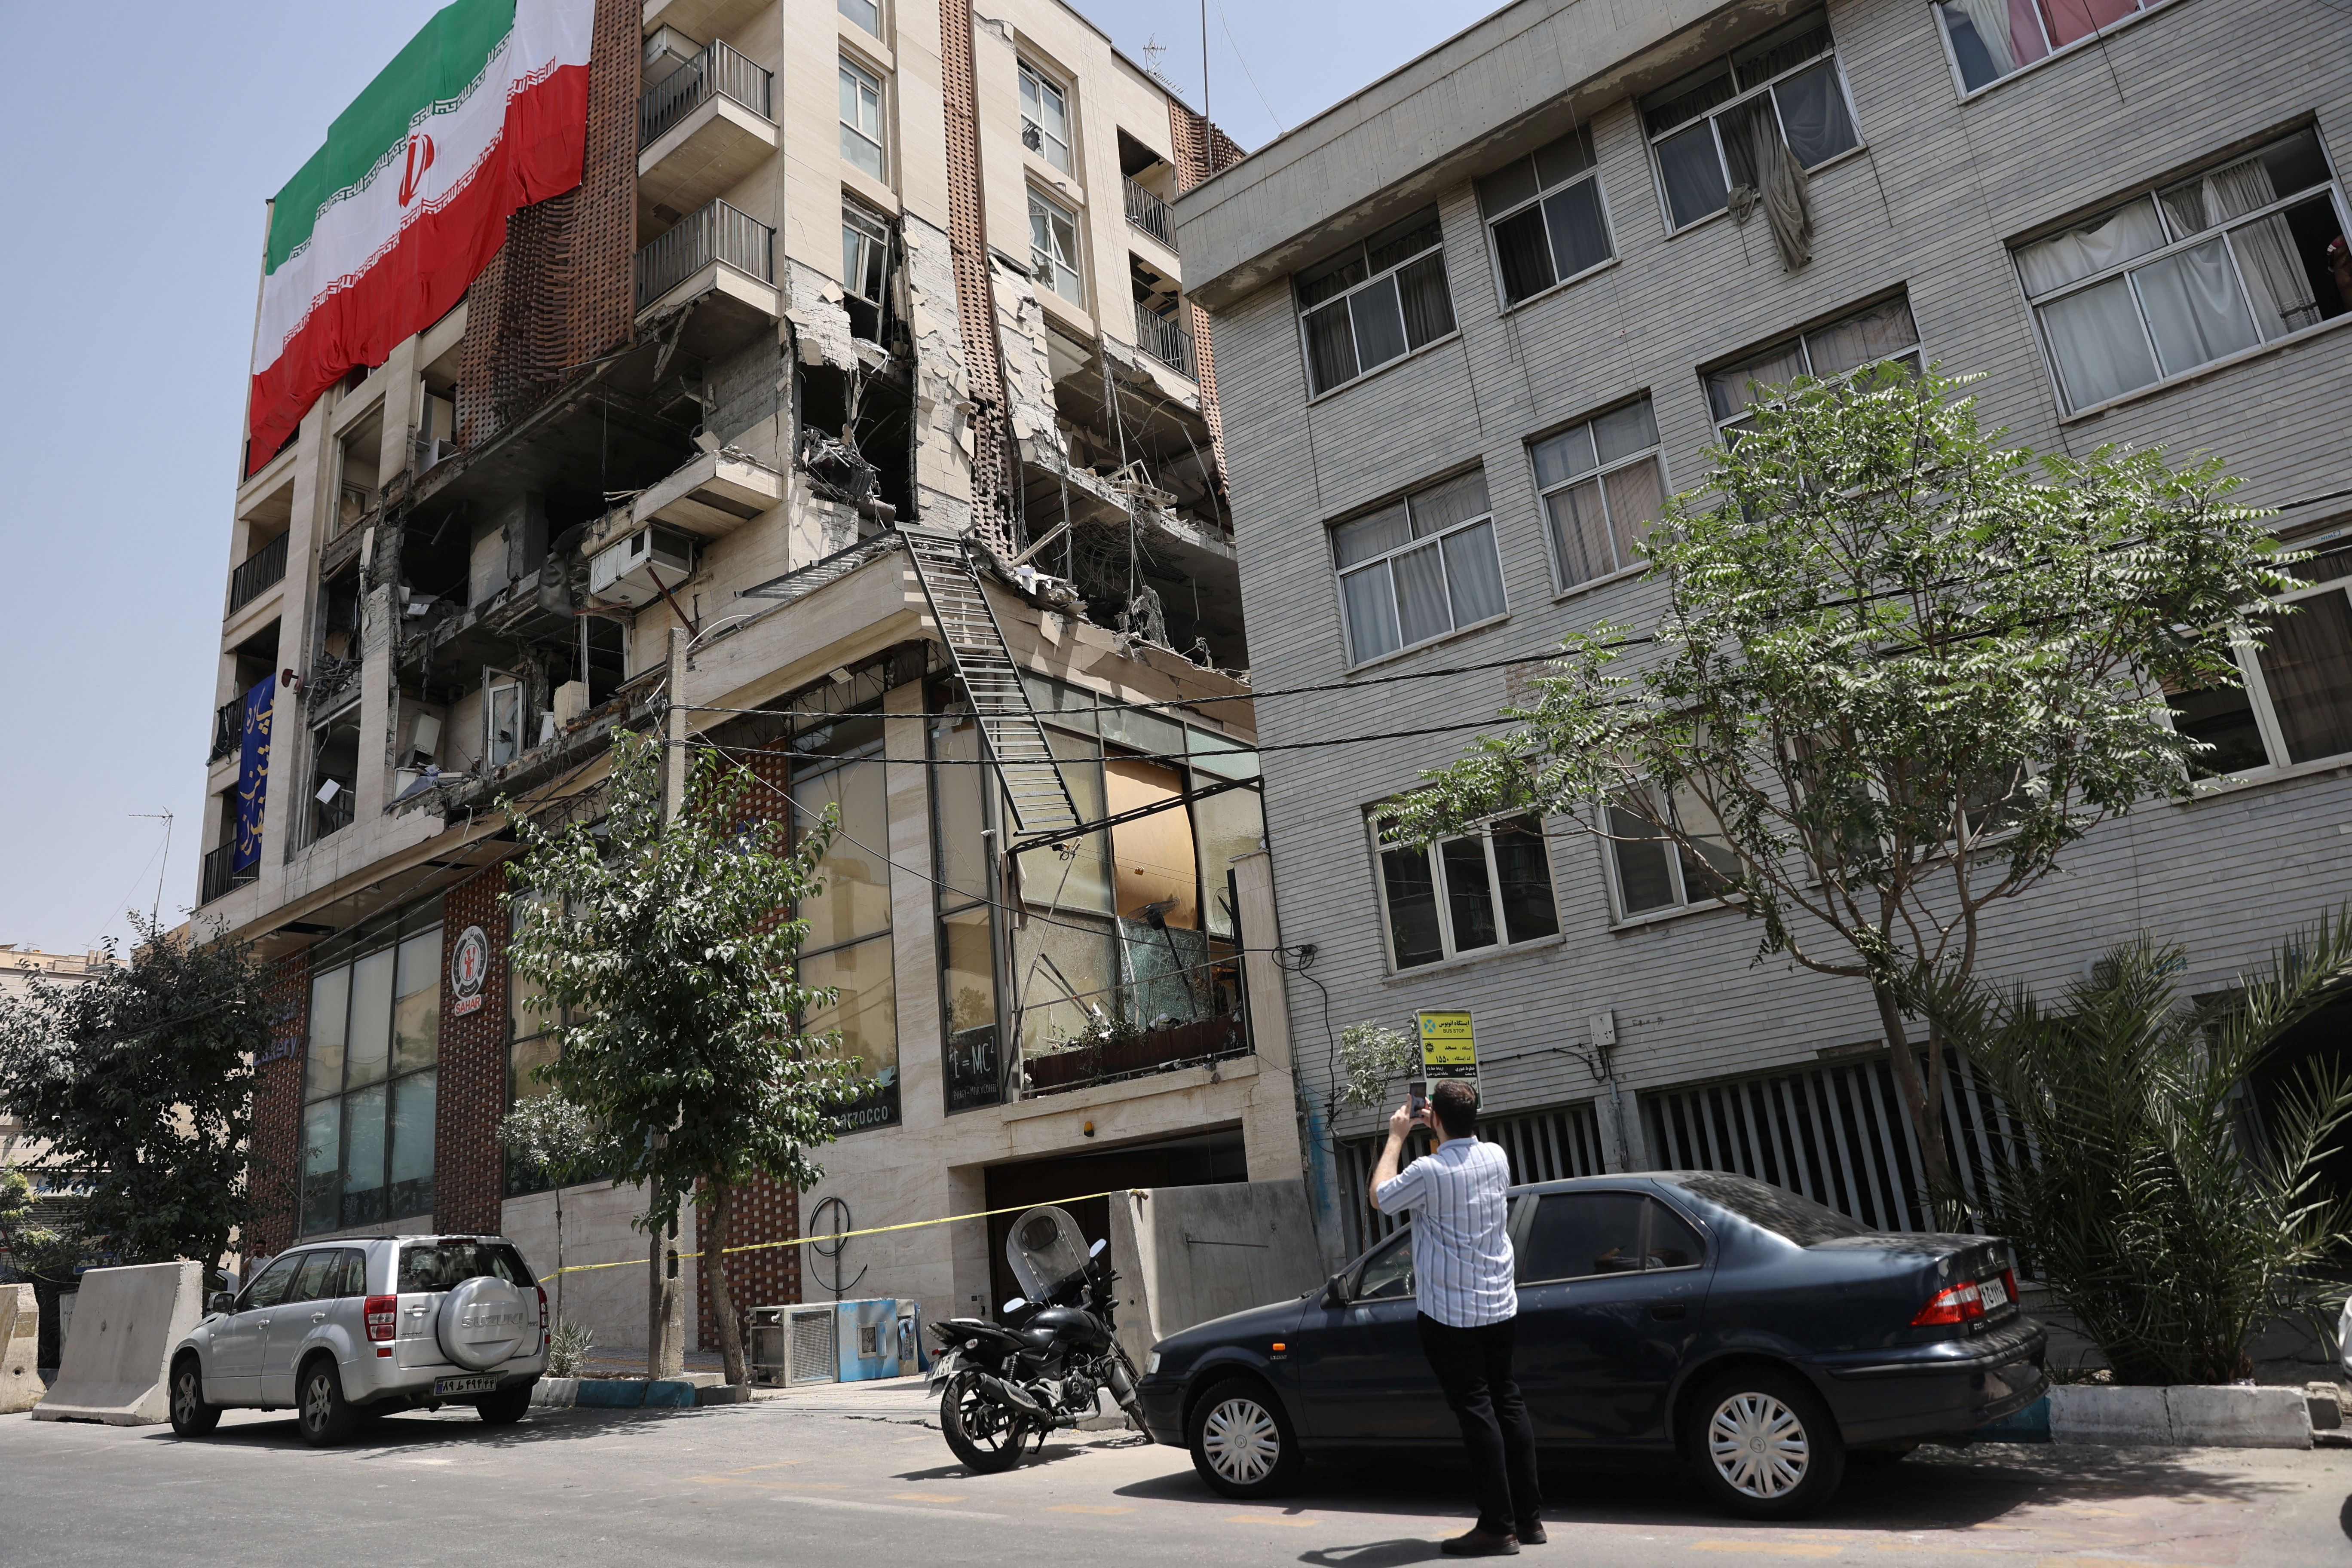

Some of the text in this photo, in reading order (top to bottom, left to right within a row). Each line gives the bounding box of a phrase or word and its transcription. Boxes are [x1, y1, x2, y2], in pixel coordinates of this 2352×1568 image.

[456, 996, 481, 1014] SAHAR
[461, 1312, 523, 1328] SUZUKI
[443, 1381, 454, 1391] ۸۹
[456, 1380, 464, 1390] ط
[466, 1378, 482, 1389] ۴۹۴
